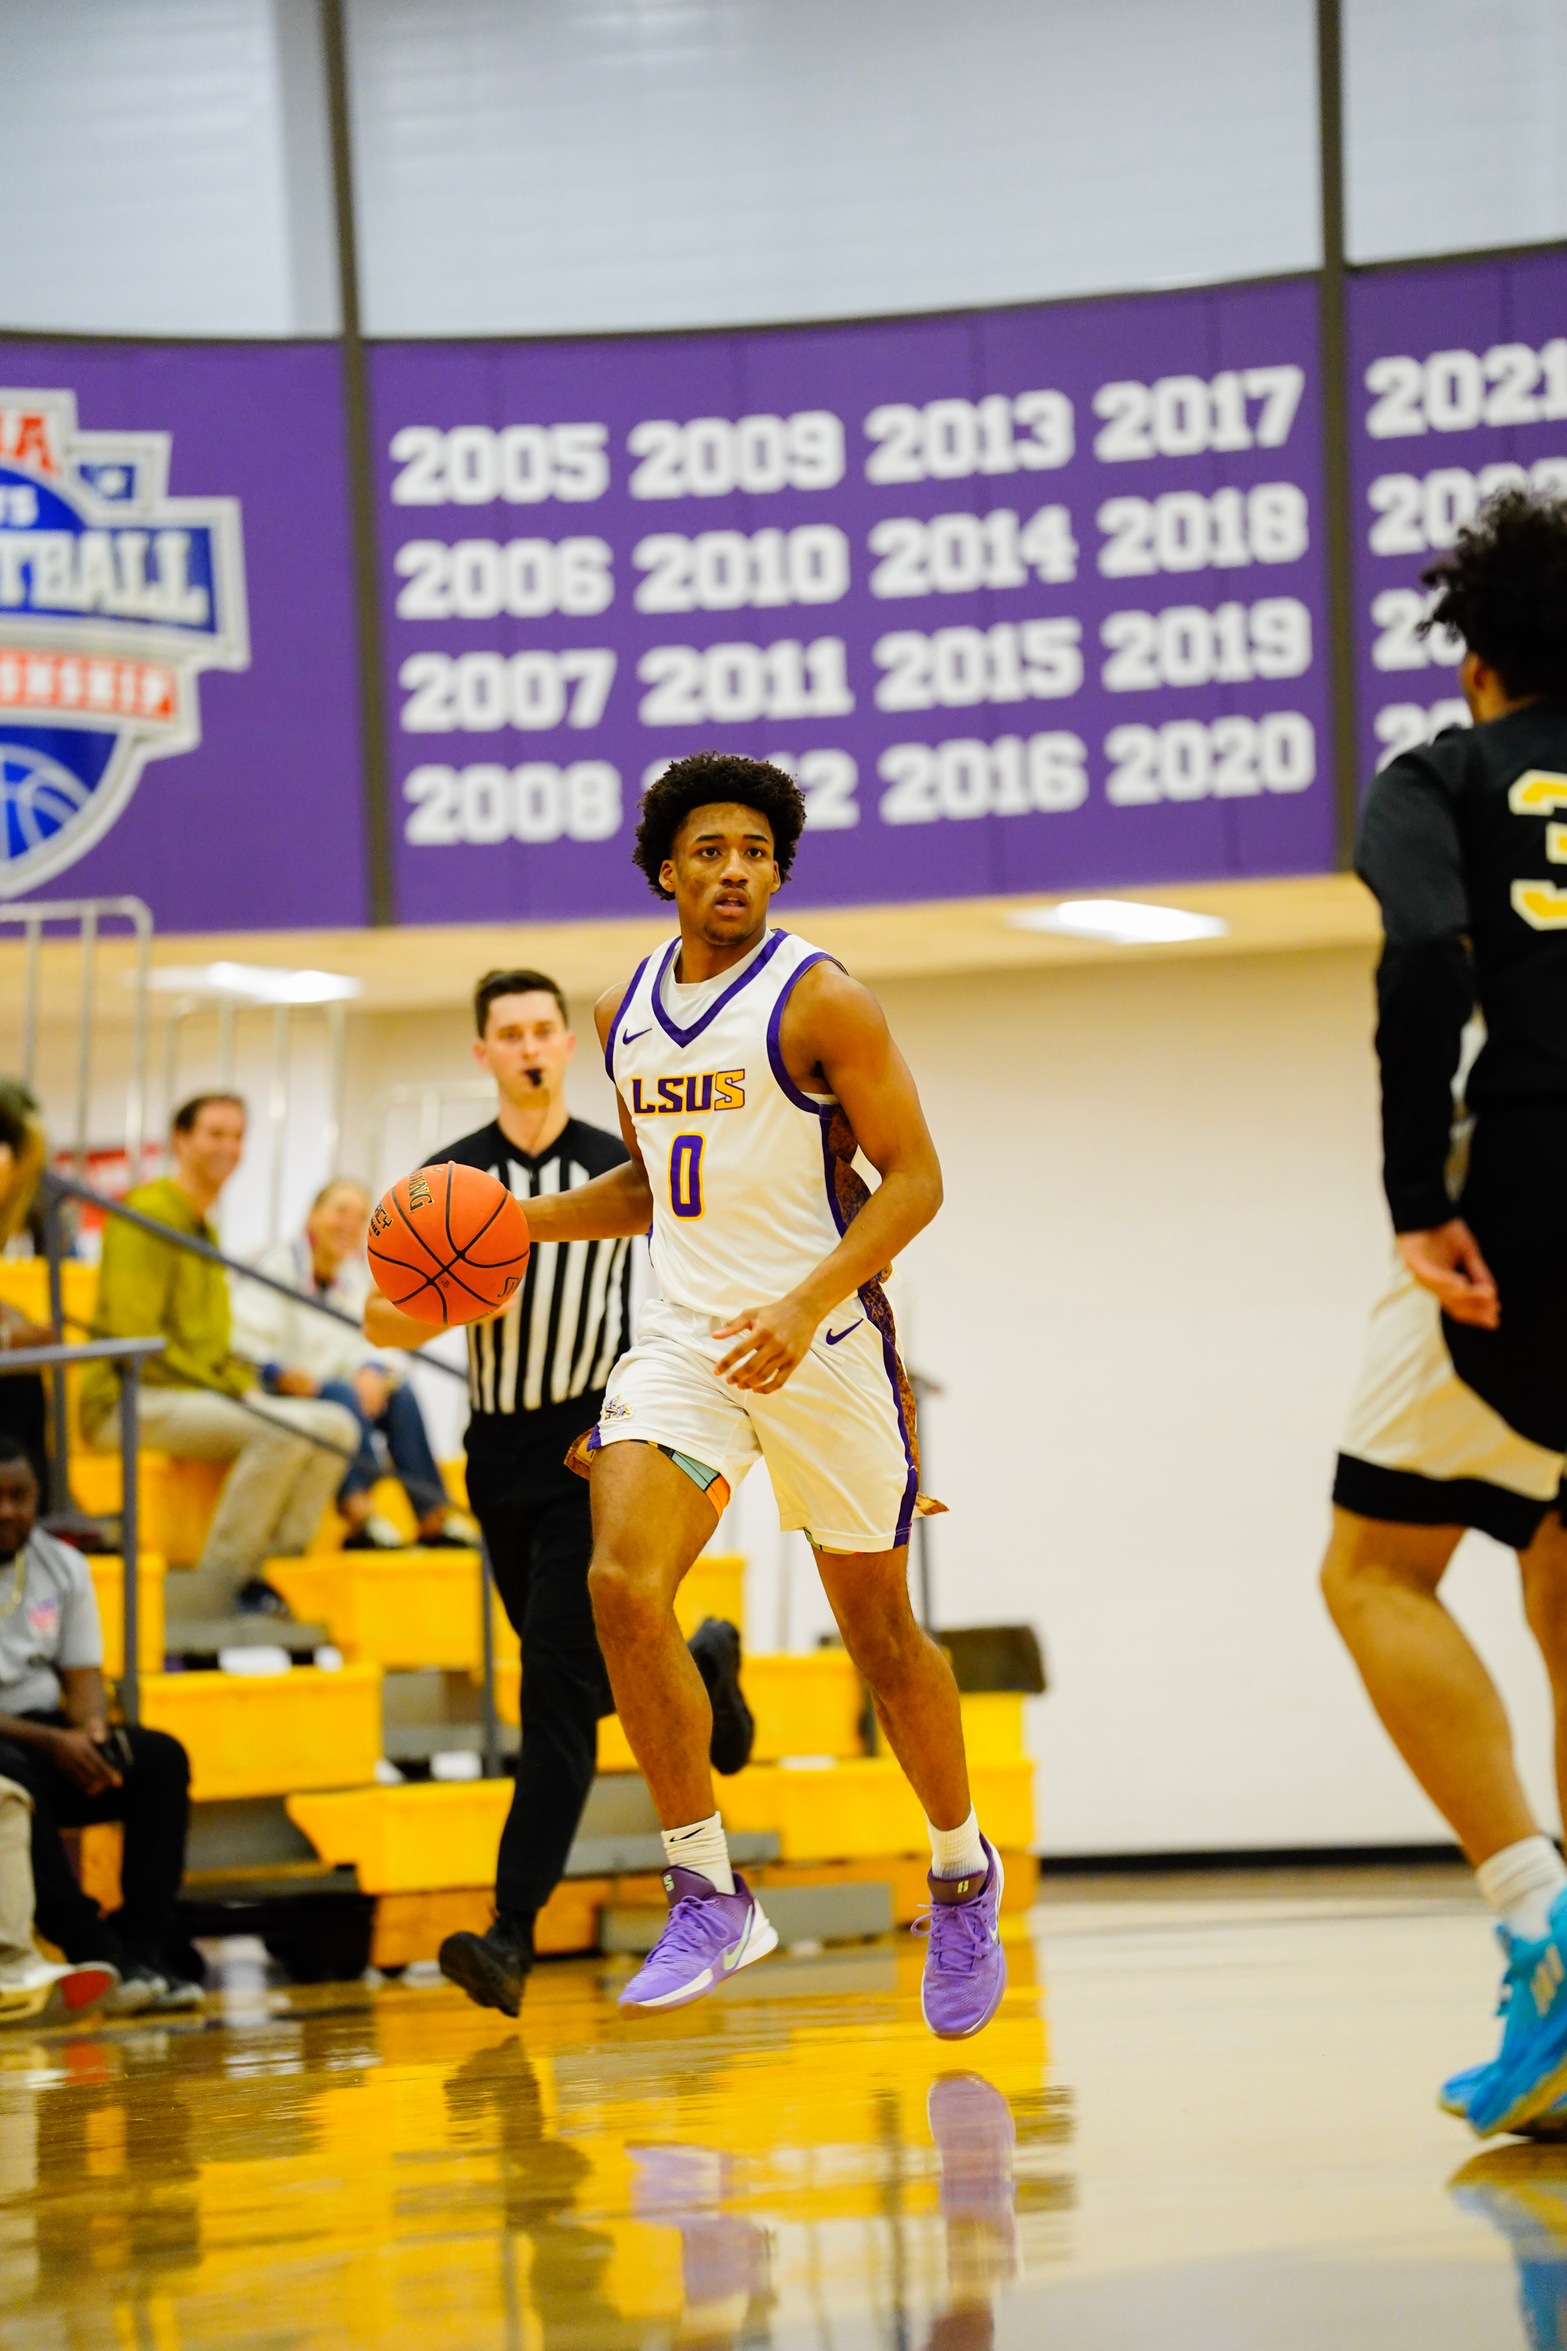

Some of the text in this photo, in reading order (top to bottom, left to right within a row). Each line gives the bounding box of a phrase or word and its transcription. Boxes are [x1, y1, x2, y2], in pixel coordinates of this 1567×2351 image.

[388, 364, 1305, 507] 2005 2009 2013 2017
[1365, 338, 1567, 439] 2021
[393, 481, 1309, 621] 2006 2010 2014 2018
[398, 647, 618, 734] 2007
[636, 635, 856, 728] 2011
[871, 616, 1085, 714] 2015
[1098, 596, 1313, 693] 2019
[402, 759, 624, 847] 2008
[876, 730, 1090, 826] 2016
[1103, 710, 1316, 807] 2020
[1508, 768, 1567, 931] 3
[630, 1068, 746, 1117] LSUS
[668, 1130, 707, 1221] 0
